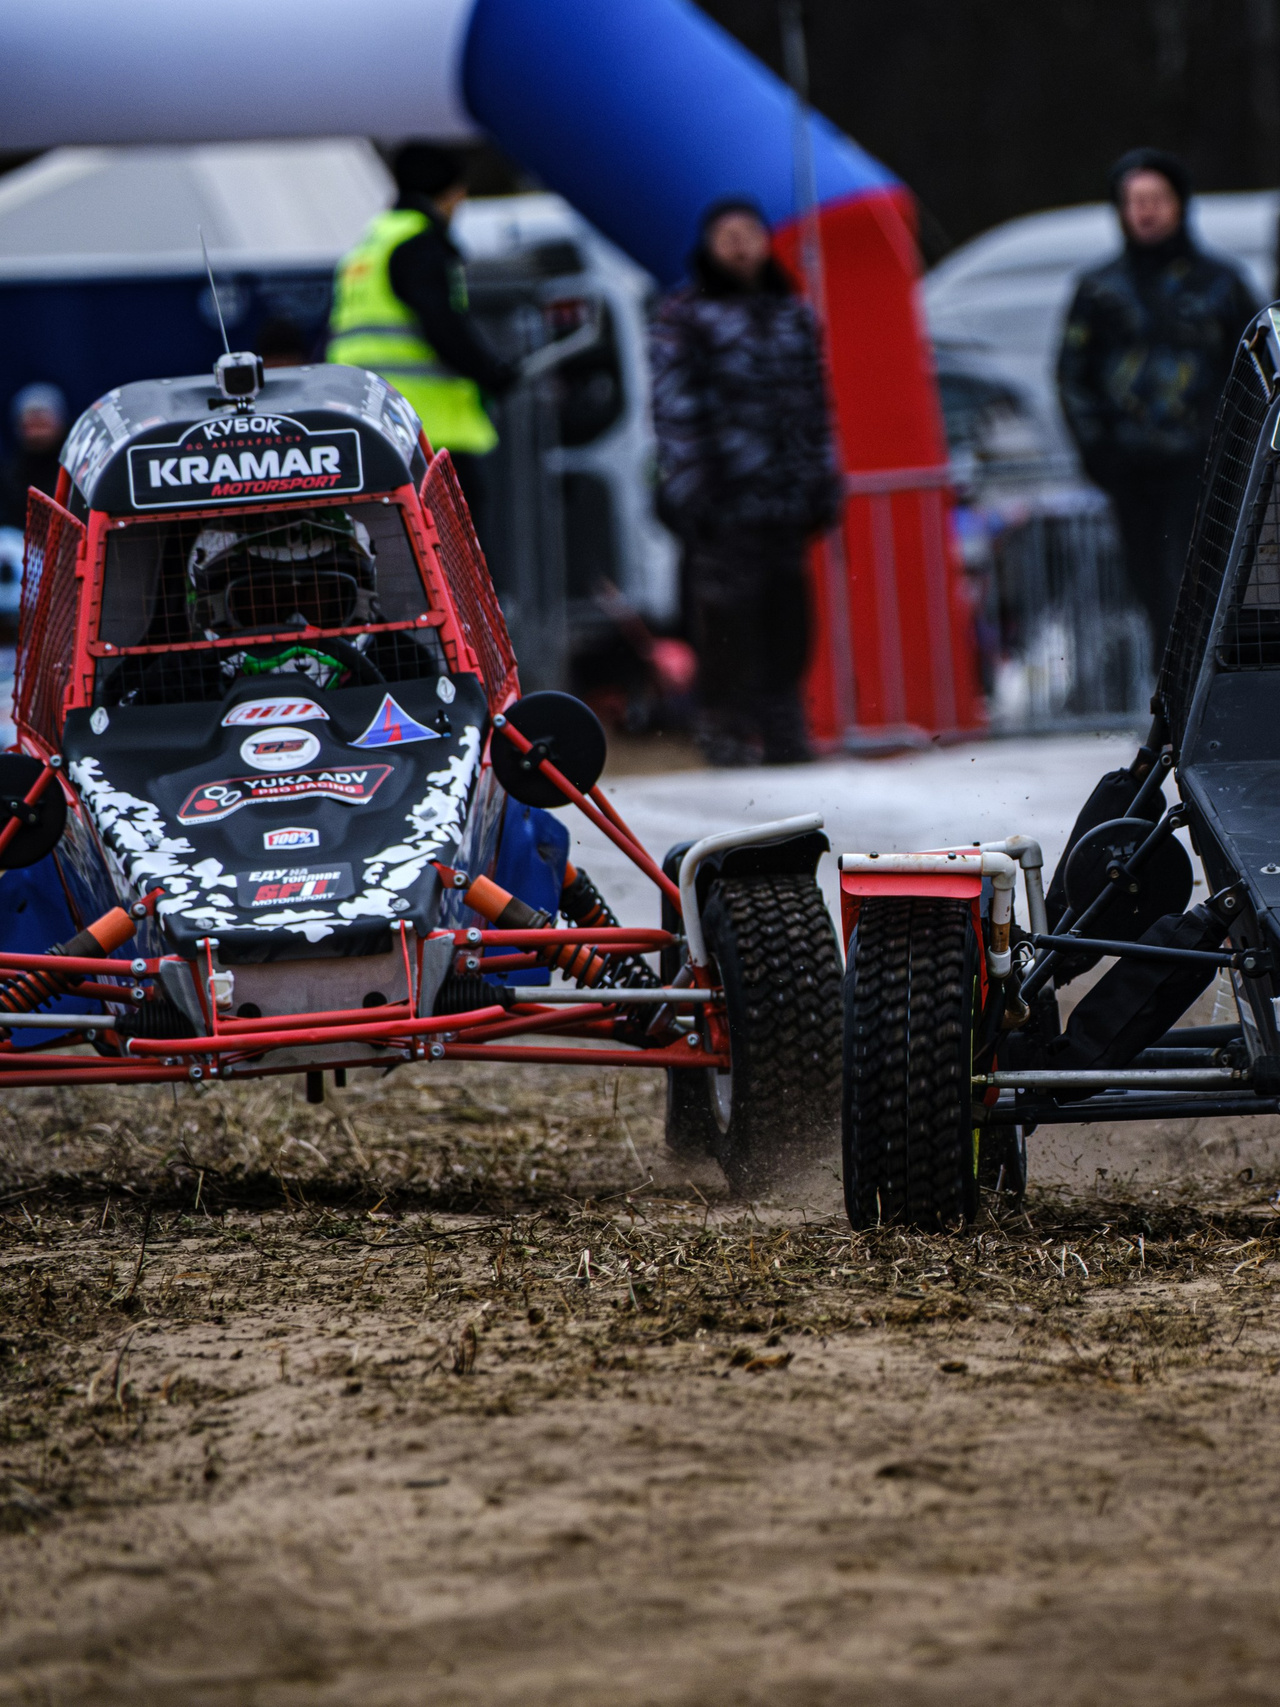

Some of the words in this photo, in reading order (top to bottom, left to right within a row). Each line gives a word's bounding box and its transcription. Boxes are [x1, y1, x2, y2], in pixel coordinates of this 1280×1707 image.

[203, 417, 283, 440] КУБОК
[149, 446, 341, 488] KRAMAR
[211, 474, 342, 497] MOTORSPORT
[244, 775, 314, 789] YUKA
[317, 771, 368, 784] ADV
[258, 786, 291, 795] PRO
[296, 782, 356, 794] RACING
[271, 832, 313, 846] 100%
[248, 868, 289, 883] ЕДУ
[289, 867, 309, 876] НА
[282, 871, 341, 885] ТОПЛИВЕ
[251, 892, 335, 907] MOTORSPORT
